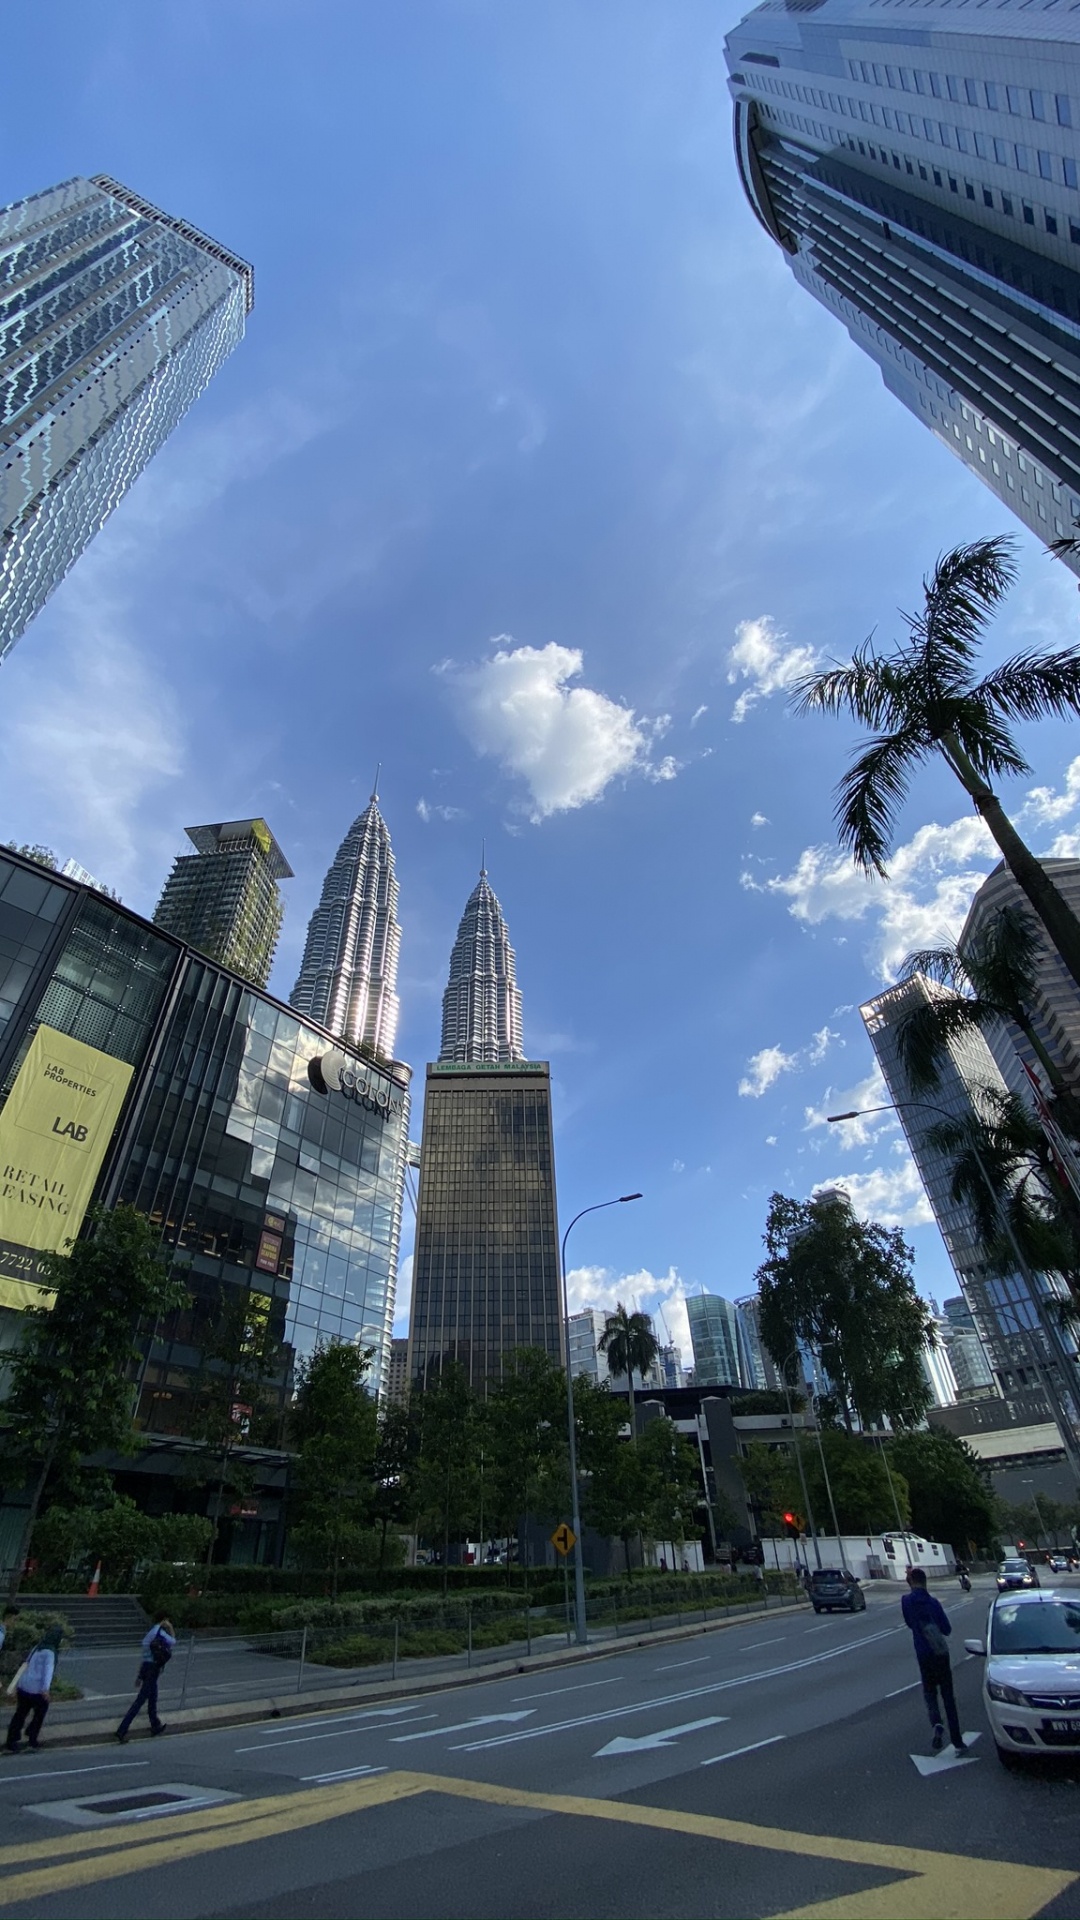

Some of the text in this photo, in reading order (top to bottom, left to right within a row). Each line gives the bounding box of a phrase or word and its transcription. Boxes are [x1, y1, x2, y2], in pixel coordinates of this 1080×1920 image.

[46, 1063, 65, 1076] LAB
[503, 1063, 542, 1071] MALAYSIA
[43, 1069, 97, 1097] PROPERTIES
[342, 1069, 404, 1119] COLONY
[52, 1116, 89, 1142] LAB
[3, 1165, 68, 1198] RETAIL
[0, 1251, 34, 1271] 7722
